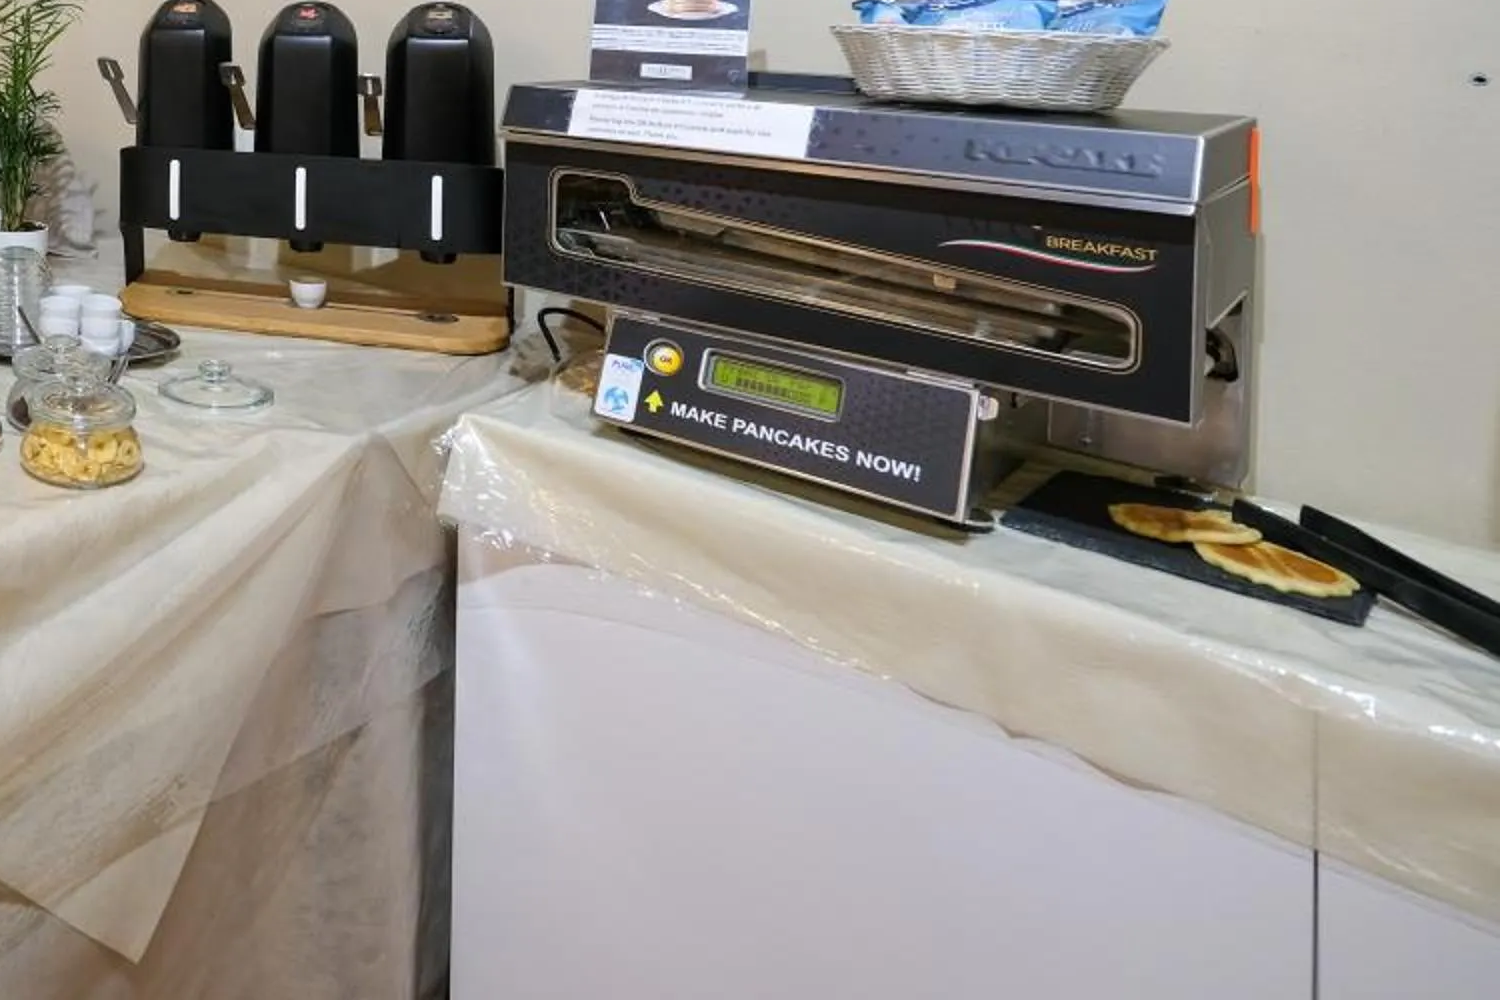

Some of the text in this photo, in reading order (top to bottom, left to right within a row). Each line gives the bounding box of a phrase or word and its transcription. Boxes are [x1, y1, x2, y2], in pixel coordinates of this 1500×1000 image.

[1046, 236, 1157, 262] BREAKFAST
[670, 401, 922, 483] MAKE PANCAKES NOW!
